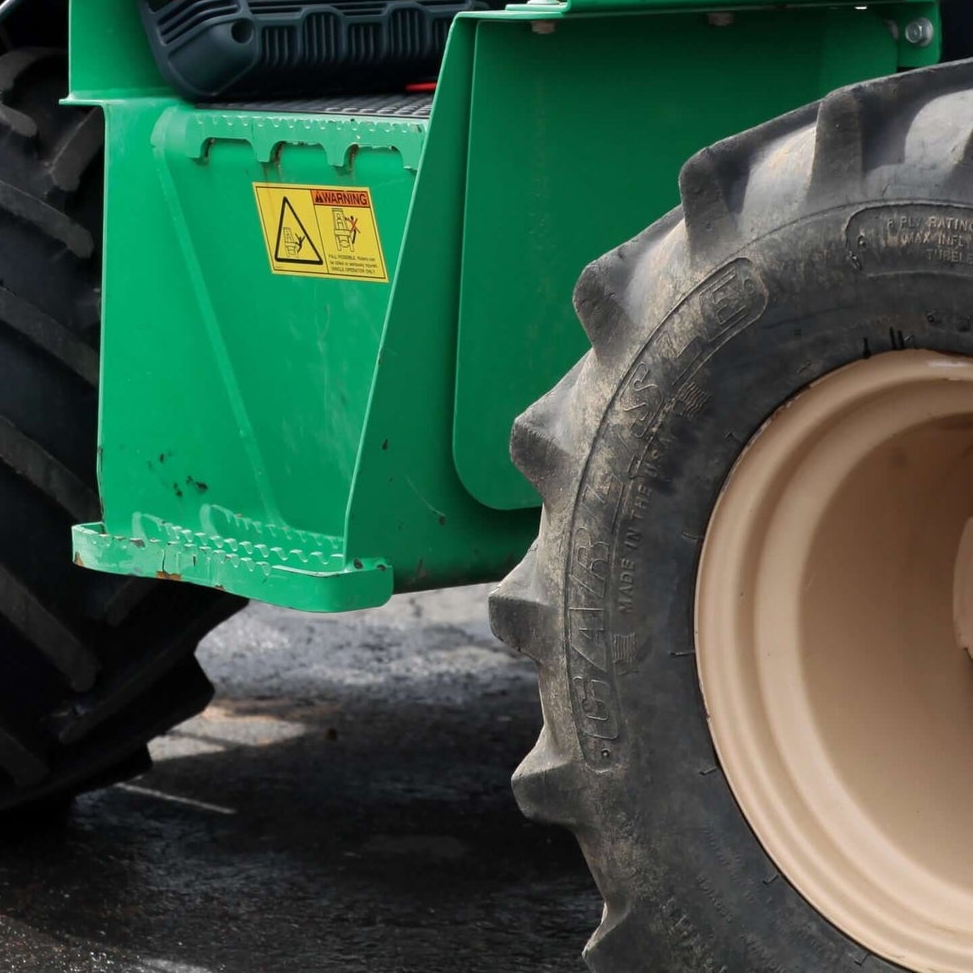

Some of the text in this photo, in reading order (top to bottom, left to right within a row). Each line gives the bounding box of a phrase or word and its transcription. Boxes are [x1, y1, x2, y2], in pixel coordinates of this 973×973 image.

[323, 192, 368, 205] WARNING
[631, 481, 655, 521] THE
[627, 529, 644, 554] IN
[617, 558, 635, 614] MADE
